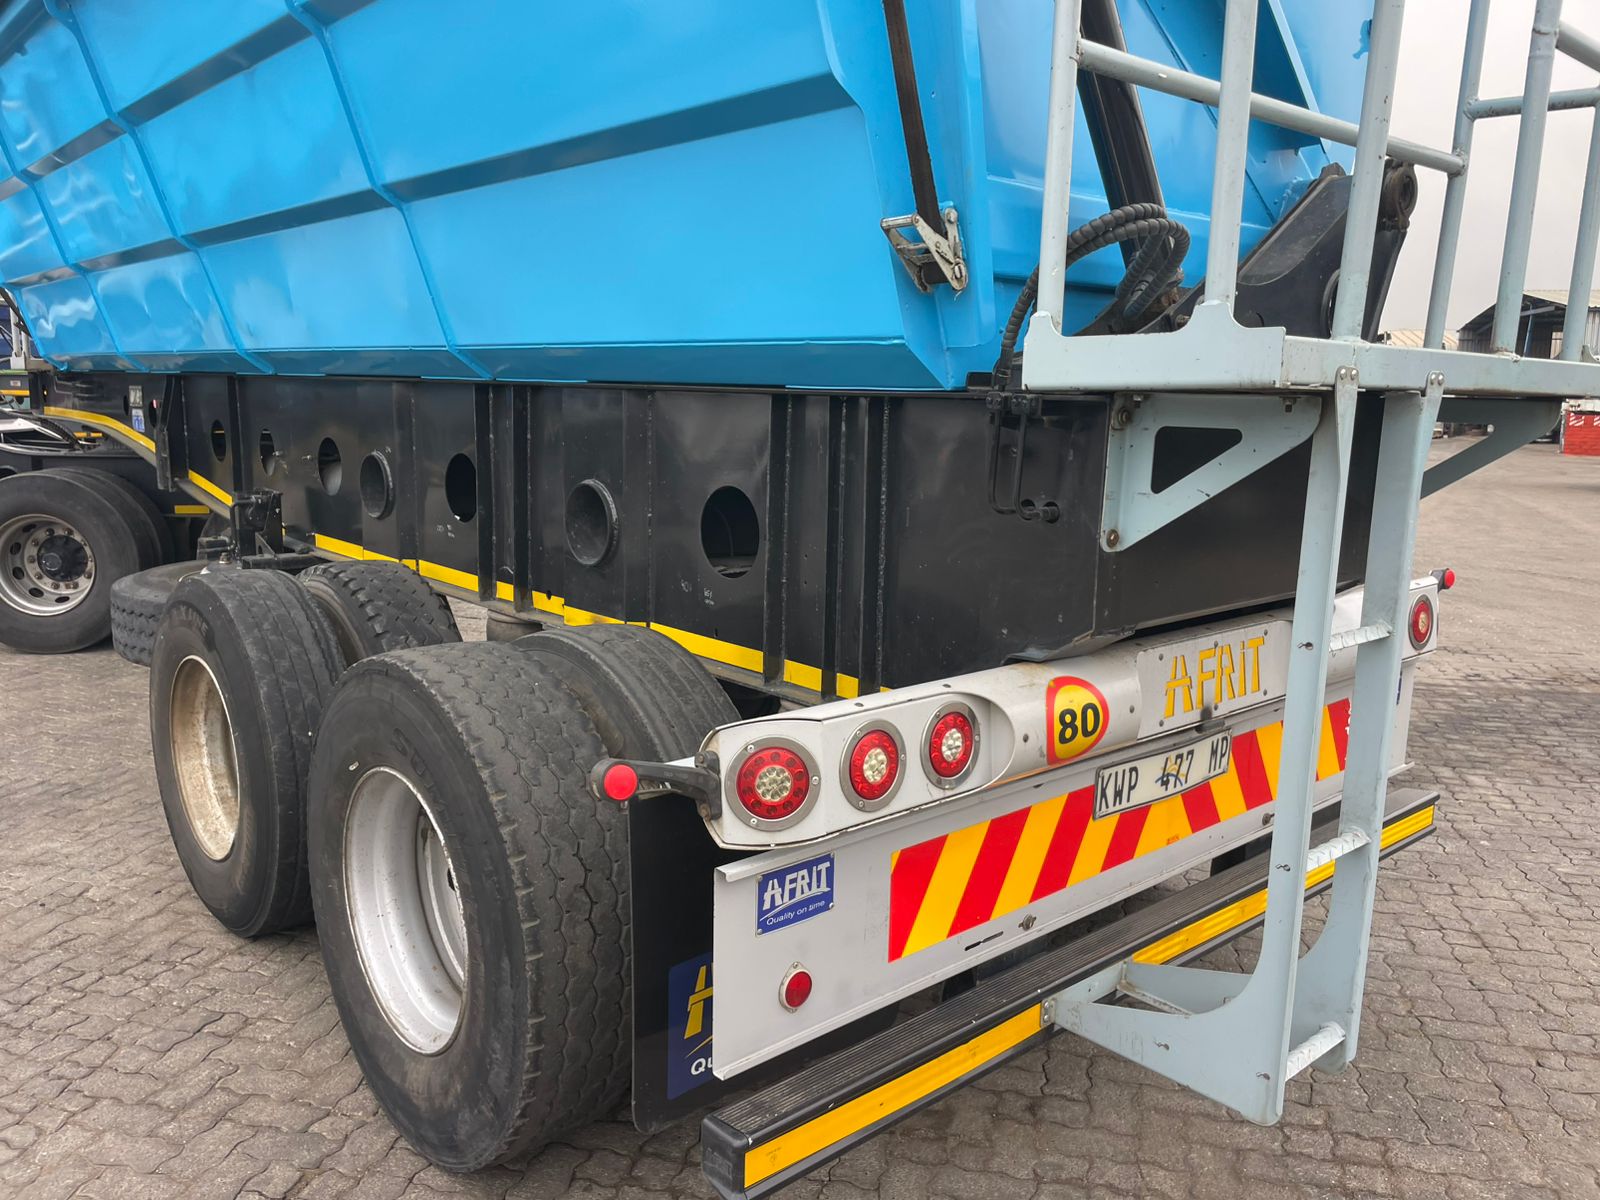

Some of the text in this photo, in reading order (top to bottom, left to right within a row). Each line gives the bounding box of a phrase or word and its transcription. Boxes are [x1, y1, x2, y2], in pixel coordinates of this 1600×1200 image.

[1163, 636, 1265, 719] AFRIT
[1058, 702, 1101, 745] 80
[1098, 735, 1229, 811] KWP 477 MP
[762, 861, 831, 911] AFRIT
[766, 900, 826, 926] Quality on time
